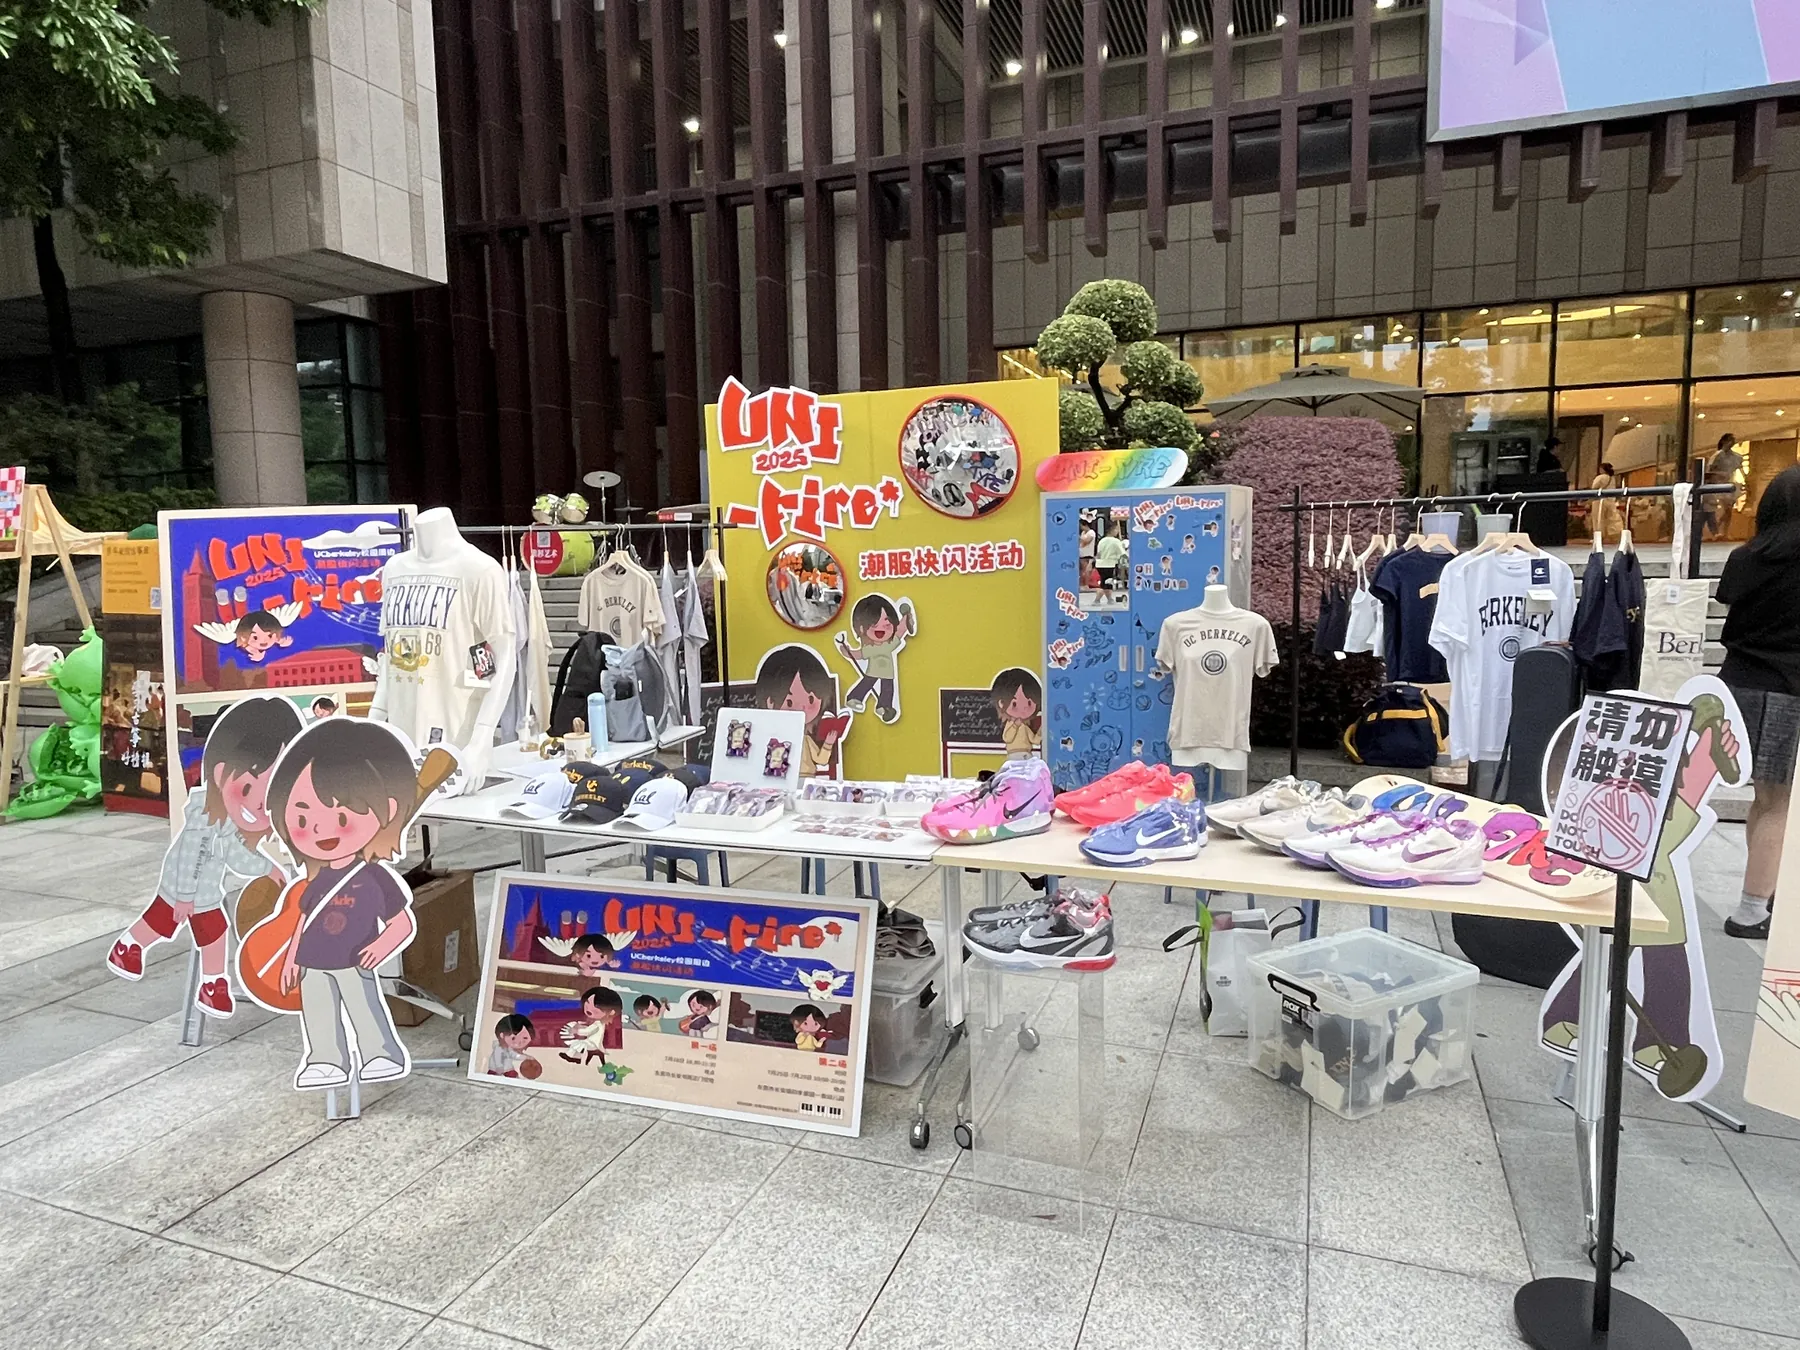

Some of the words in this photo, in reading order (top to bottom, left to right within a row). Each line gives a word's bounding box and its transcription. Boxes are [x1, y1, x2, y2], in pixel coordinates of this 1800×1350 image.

[720, 379, 840, 461] UNI
[755, 447, 809, 472] 2025
[208, 532, 308, 581] UNI
[860, 542, 1024, 578] 潮服快闪活动
[245, 566, 285, 587] 2025
[424, 631, 442, 657] 68
[1183, 634, 1197, 648] UC
[1199, 628, 1252, 649] BERKELEY
[1585, 700, 1678, 750] 请勿
[1571, 743, 1668, 799] 触摸
[522, 778, 546, 795] Cal
[632, 788, 657, 805] Cal
[1559, 809, 1579, 823] DO
[1556, 822, 1588, 836] NOT
[1553, 835, 1601, 859] TOUCH
[631, 938, 671, 950] 2025
